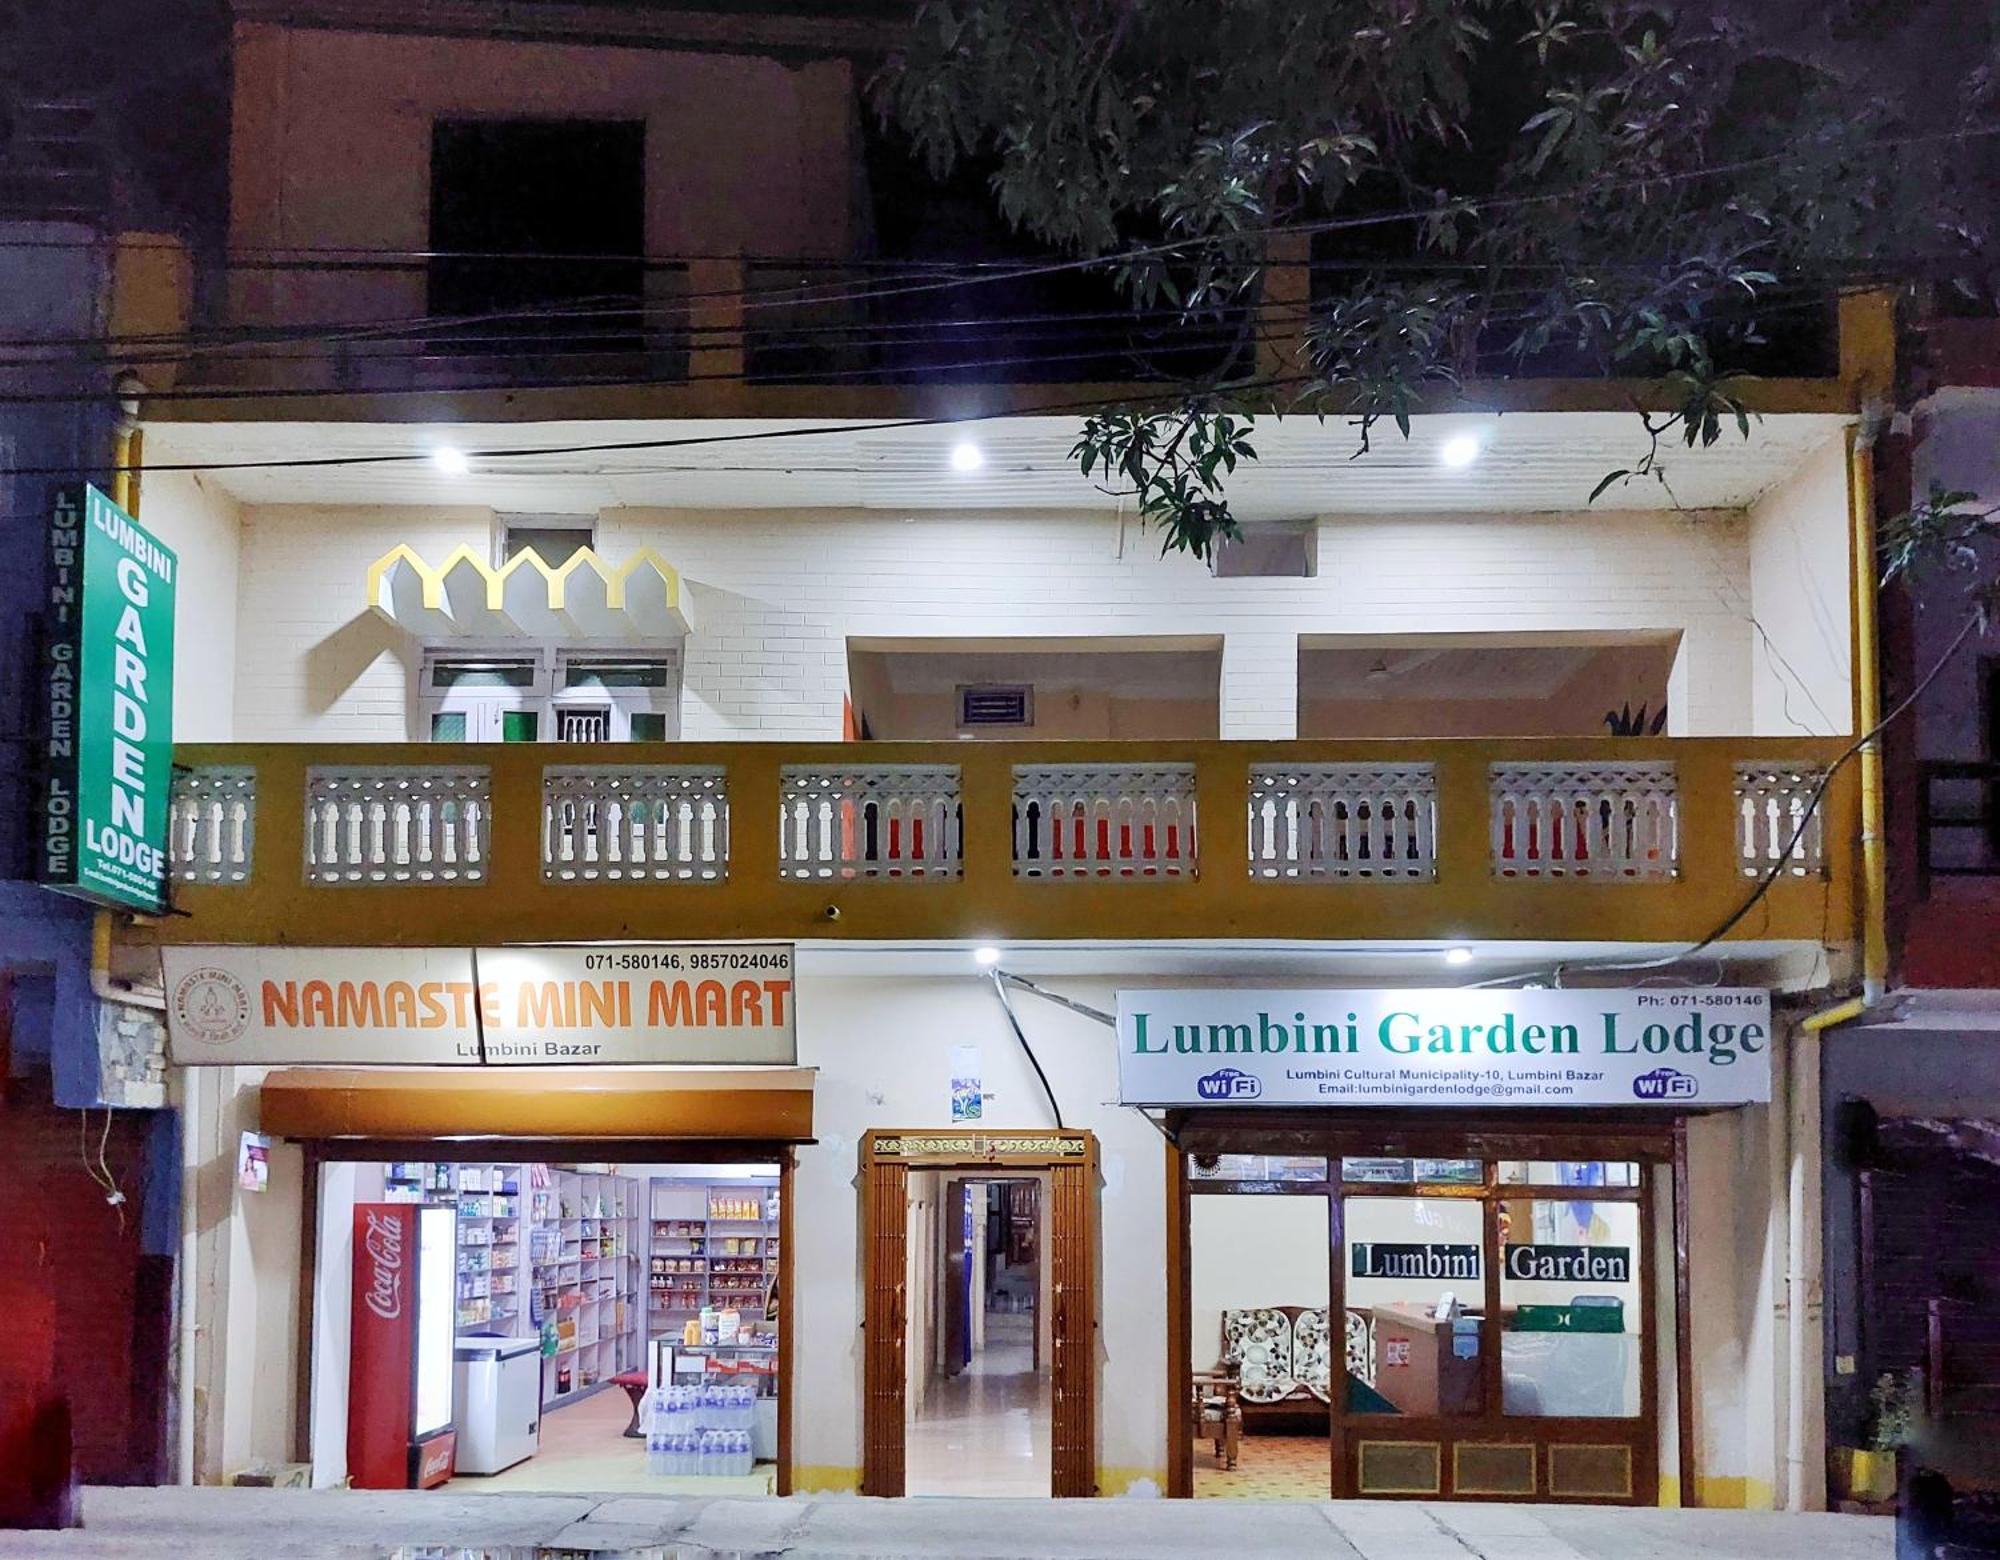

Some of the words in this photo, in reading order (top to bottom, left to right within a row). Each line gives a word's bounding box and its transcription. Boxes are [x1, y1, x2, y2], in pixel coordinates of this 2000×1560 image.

[52, 491, 78, 622] LUMBINI
[94, 498, 171, 584] LUMBINI
[50, 643, 73, 757] GARDEN
[112, 557, 148, 837] GARDEN
[47, 778, 71, 873] LODGE
[86, 818, 164, 879] LODGE
[585, 953, 685, 972] 071-580146,
[690, 953, 789, 970] 9857024046
[262, 980, 501, 1029] NAMASTE
[517, 981, 632, 1029] MINI
[647, 980, 791, 1028] MART
[1637, 995, 1664, 1006] Ph:
[1670, 995, 1763, 1006] 071-580146
[456, 1041, 538, 1056] Lumbini
[545, 1042, 602, 1056] Bazar
[1131, 1011, 1361, 1054] Lumbini
[1378, 1011, 1580, 1054] Garden
[1600, 1012, 1765, 1066] Lodge
[1286, 1069, 1340, 1080] Lumbini
[1344, 1069, 1396, 1080] Cultural
[1399, 1070, 1504, 1082] Municipality-10,
[1508, 1070, 1562, 1081] Lumbini
[1566, 1070, 1605, 1081] Bazar
[1319, 1083, 1574, 1097] Email:lumbinigardenlodge@gmail.com
[1364, 1243, 1479, 1278] Lumbini
[1511, 1246, 1627, 1280] Garden
